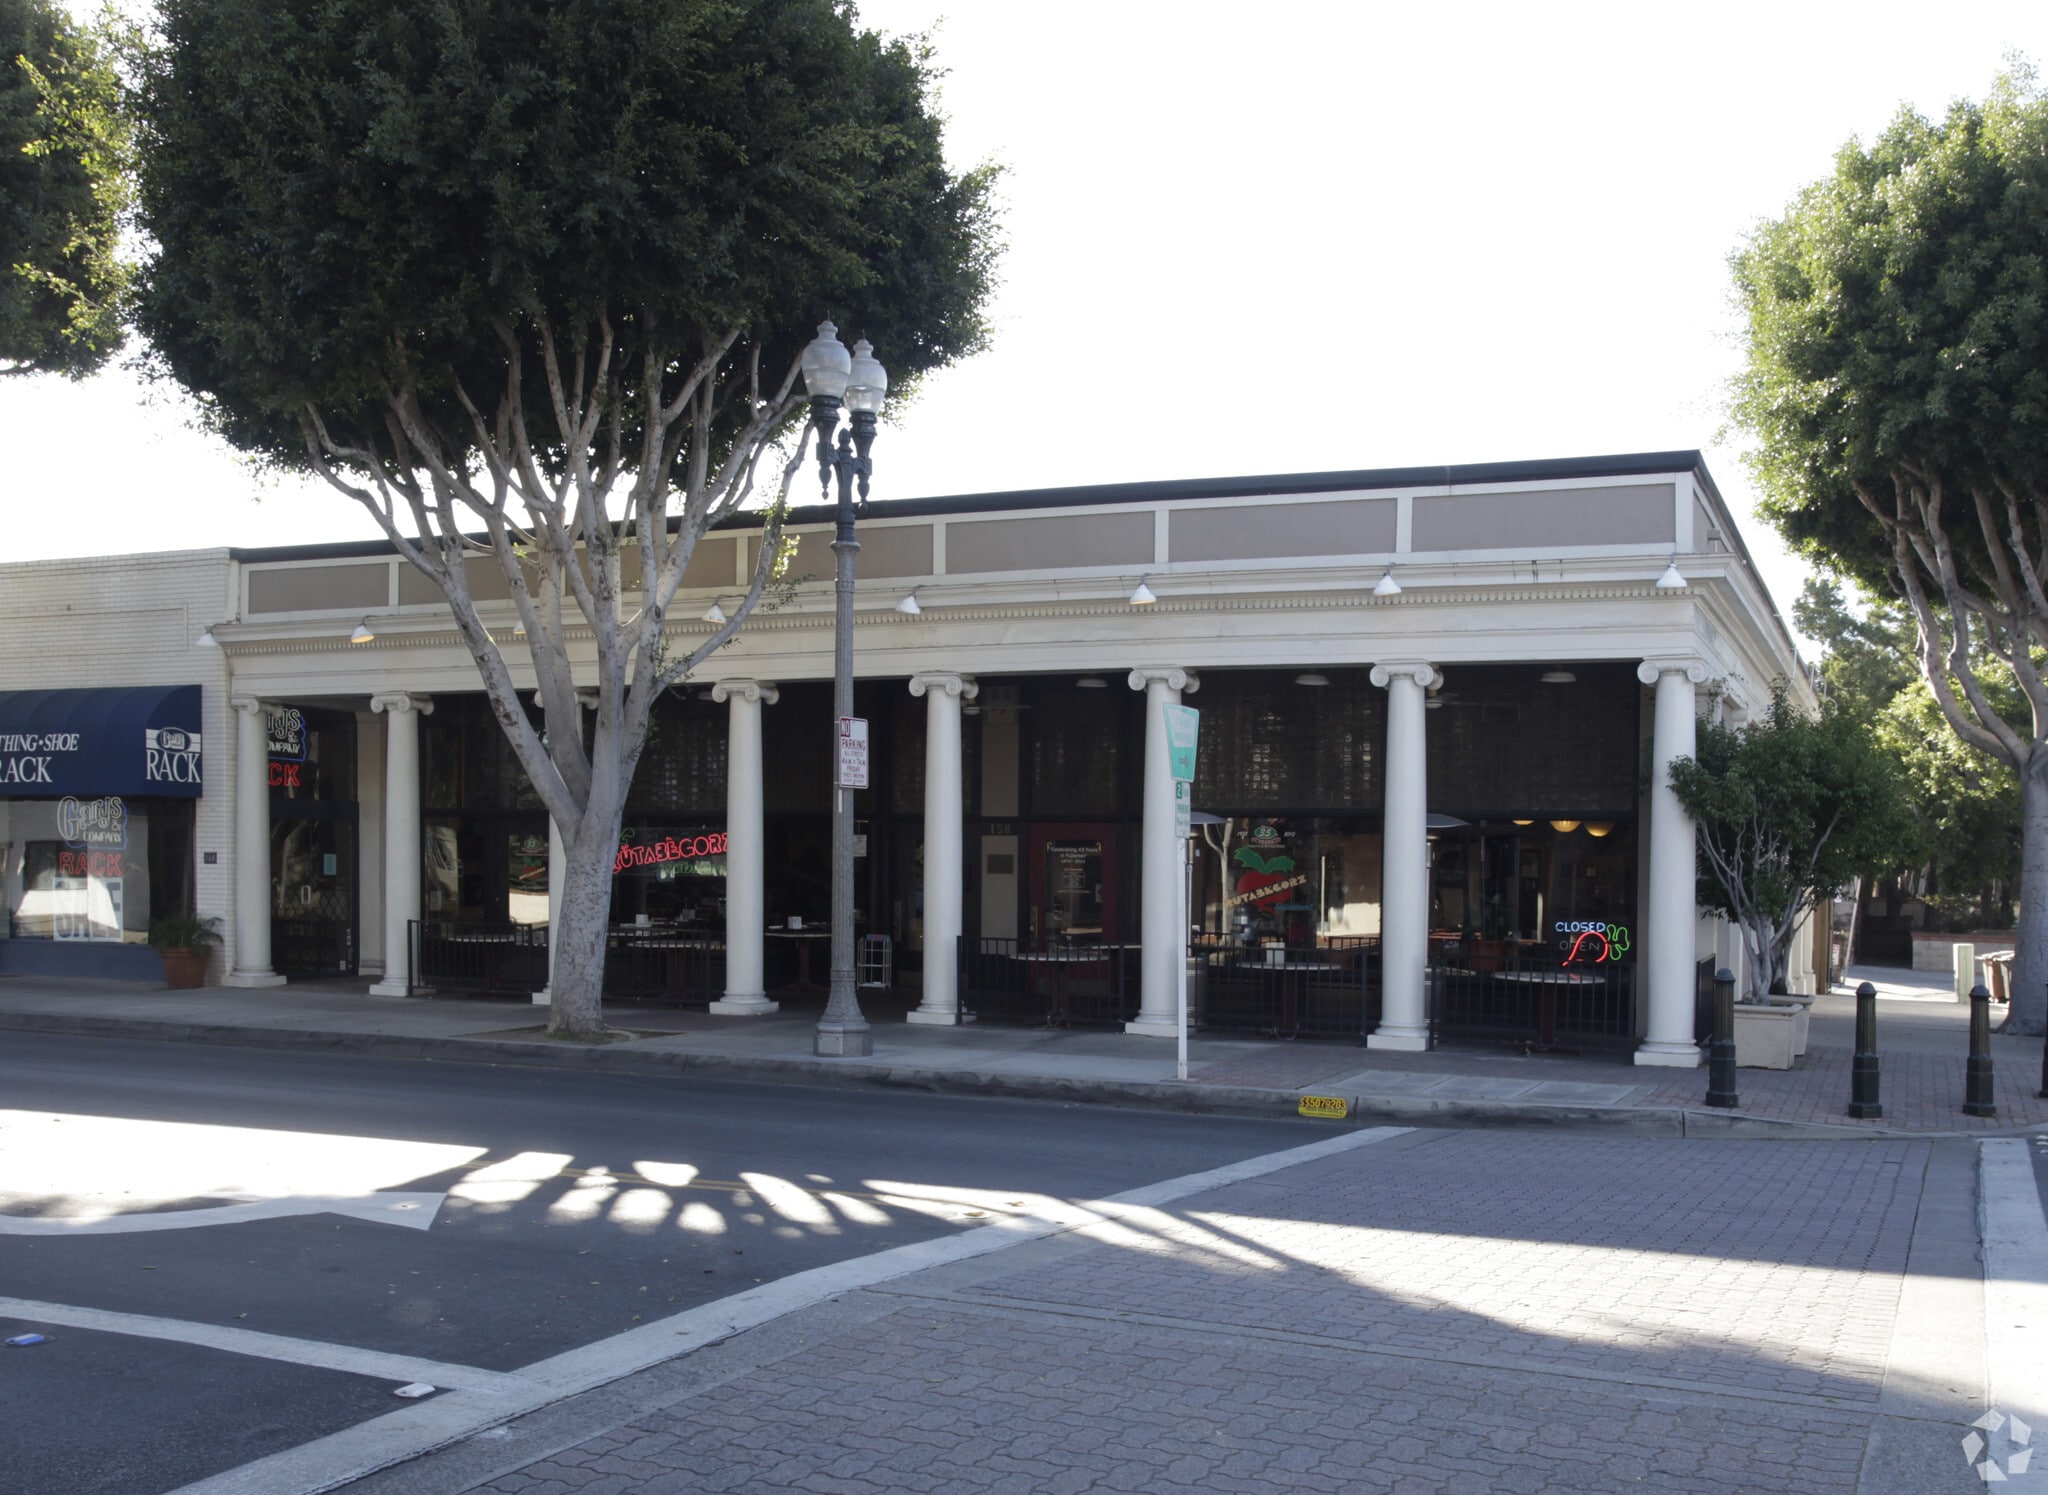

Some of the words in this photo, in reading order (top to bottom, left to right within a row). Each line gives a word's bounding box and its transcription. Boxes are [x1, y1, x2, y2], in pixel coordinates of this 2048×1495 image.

[841, 720, 850, 736] NO
[842, 738, 866, 751] PARKING
[0, 757, 53, 783] ACK
[145, 749, 201, 783] RACK
[268, 762, 301, 787] CK
[1260, 828, 1271, 837] 35
[58, 852, 123, 877] RACK
[1555, 921, 1606, 932] CLOSED
